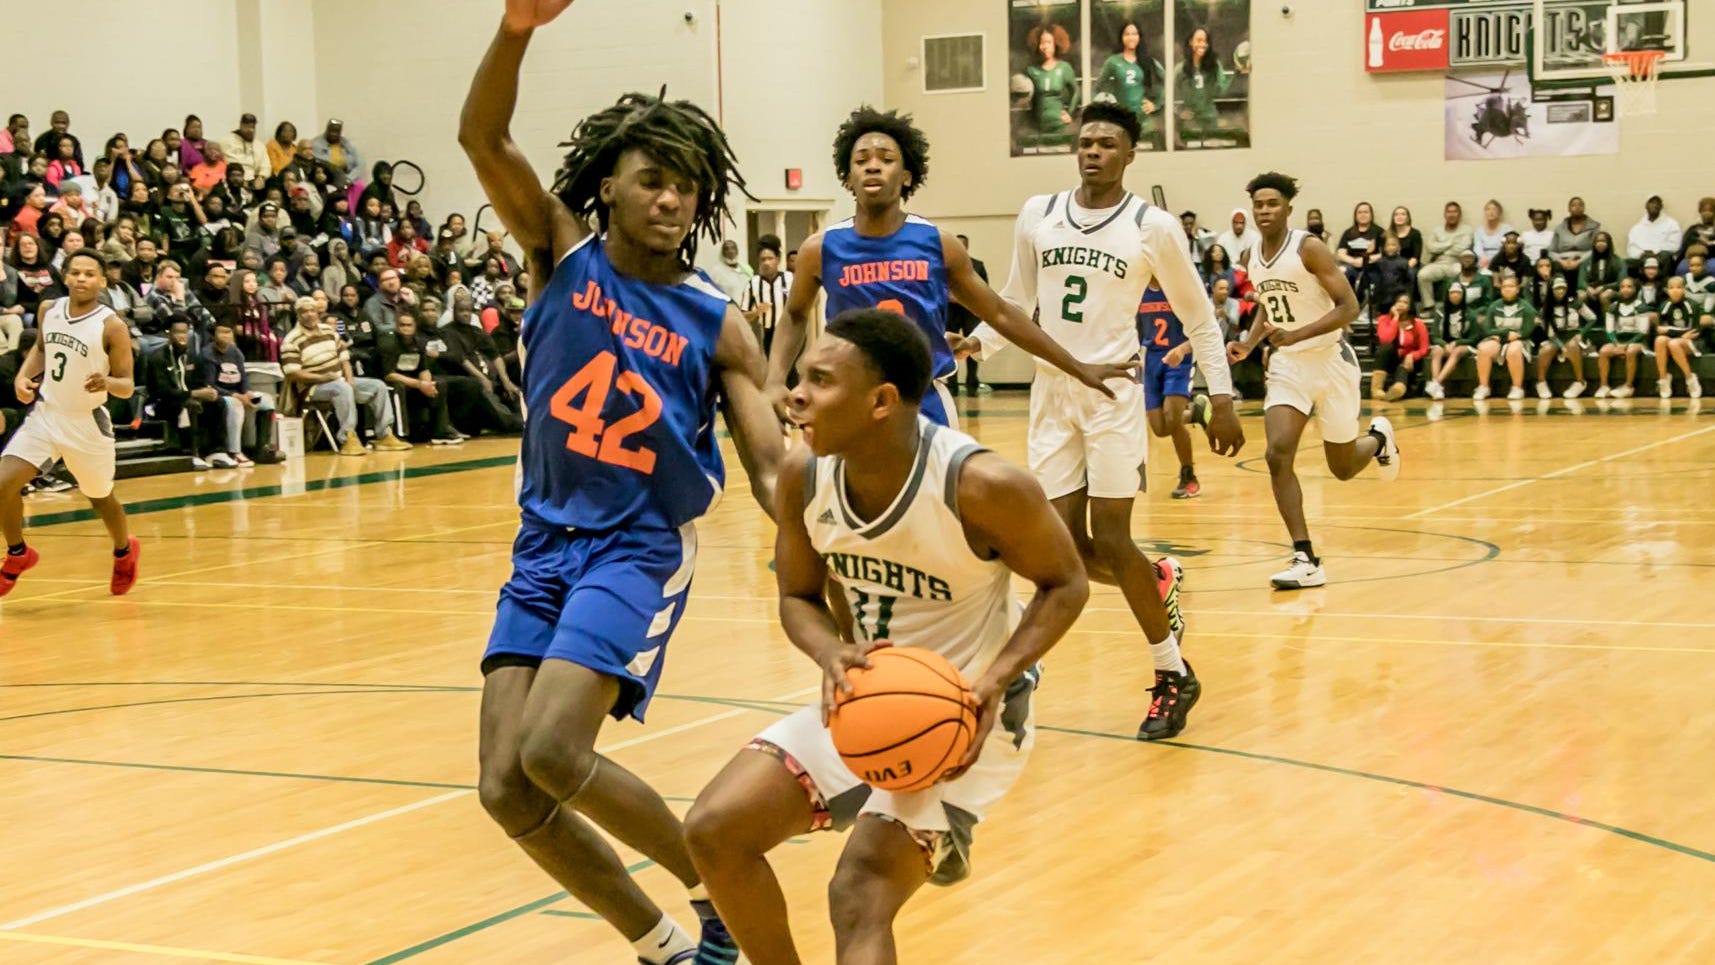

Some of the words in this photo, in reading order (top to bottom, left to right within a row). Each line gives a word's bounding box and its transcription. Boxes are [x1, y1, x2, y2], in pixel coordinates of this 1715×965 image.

[1125, 69, 1136, 85] 2
[1194, 74, 1204, 89] 3
[838, 260, 929, 287] JOHNSON
[1042, 246, 1128, 280] KNIGHTS
[1061, 274, 1088, 323] 2
[1268, 295, 1295, 323] 21
[1153, 317, 1169, 347] 2
[51, 351, 67, 382] 3
[550, 350, 663, 475] 42
[821, 552, 952, 602] NIGHTS
